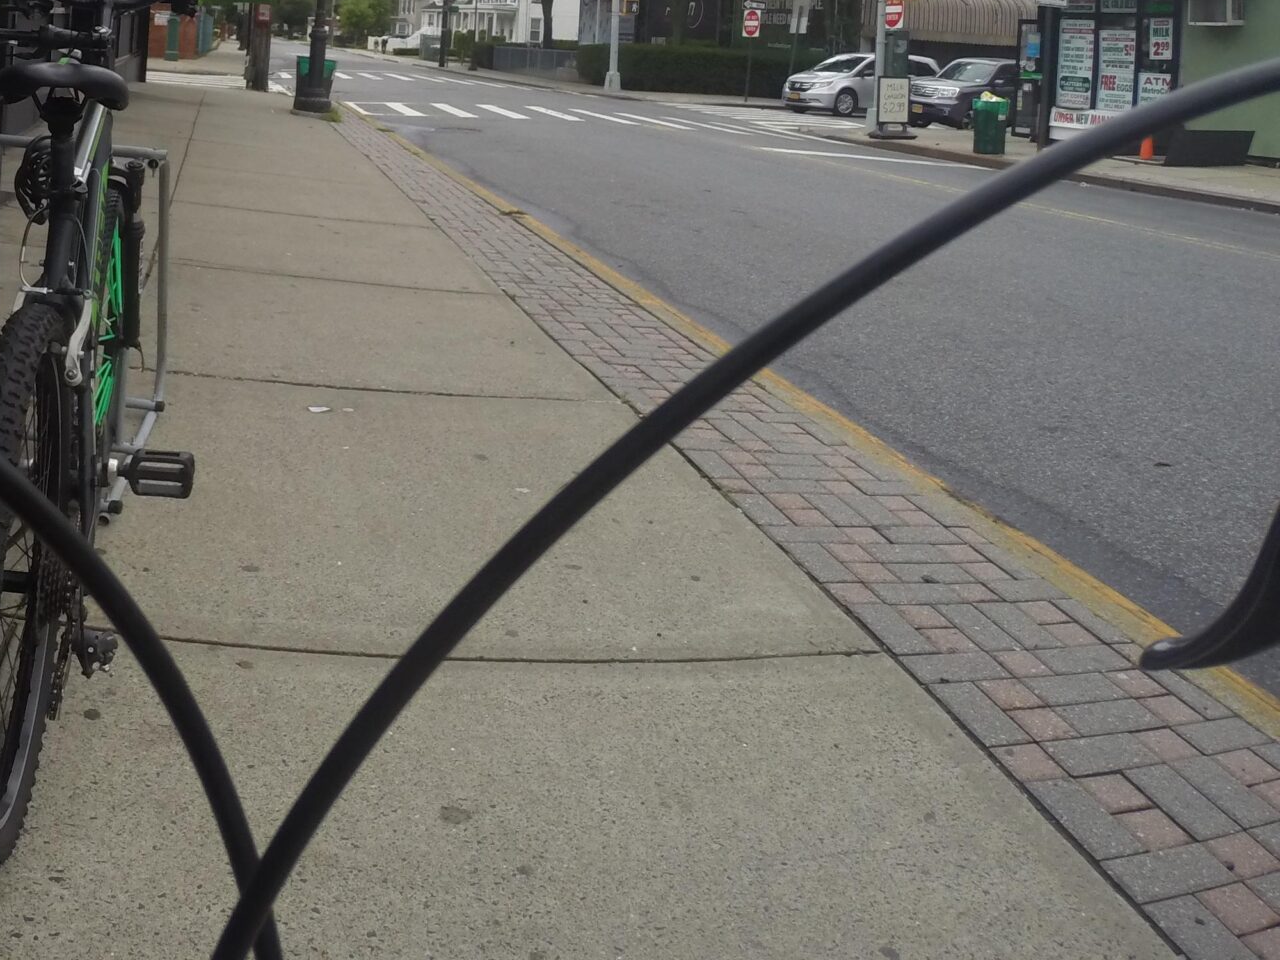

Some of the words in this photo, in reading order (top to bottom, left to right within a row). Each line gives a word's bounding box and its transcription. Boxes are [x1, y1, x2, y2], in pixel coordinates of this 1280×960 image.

[1152, 27, 1170, 38] MILK
[1100, 74, 1117, 92] FREE
[1116, 83, 1133, 93] EGGS
[1143, 76, 1172, 87] ATM
[1053, 111, 1074, 124] UNDER
[1075, 113, 1090, 125] NEW
